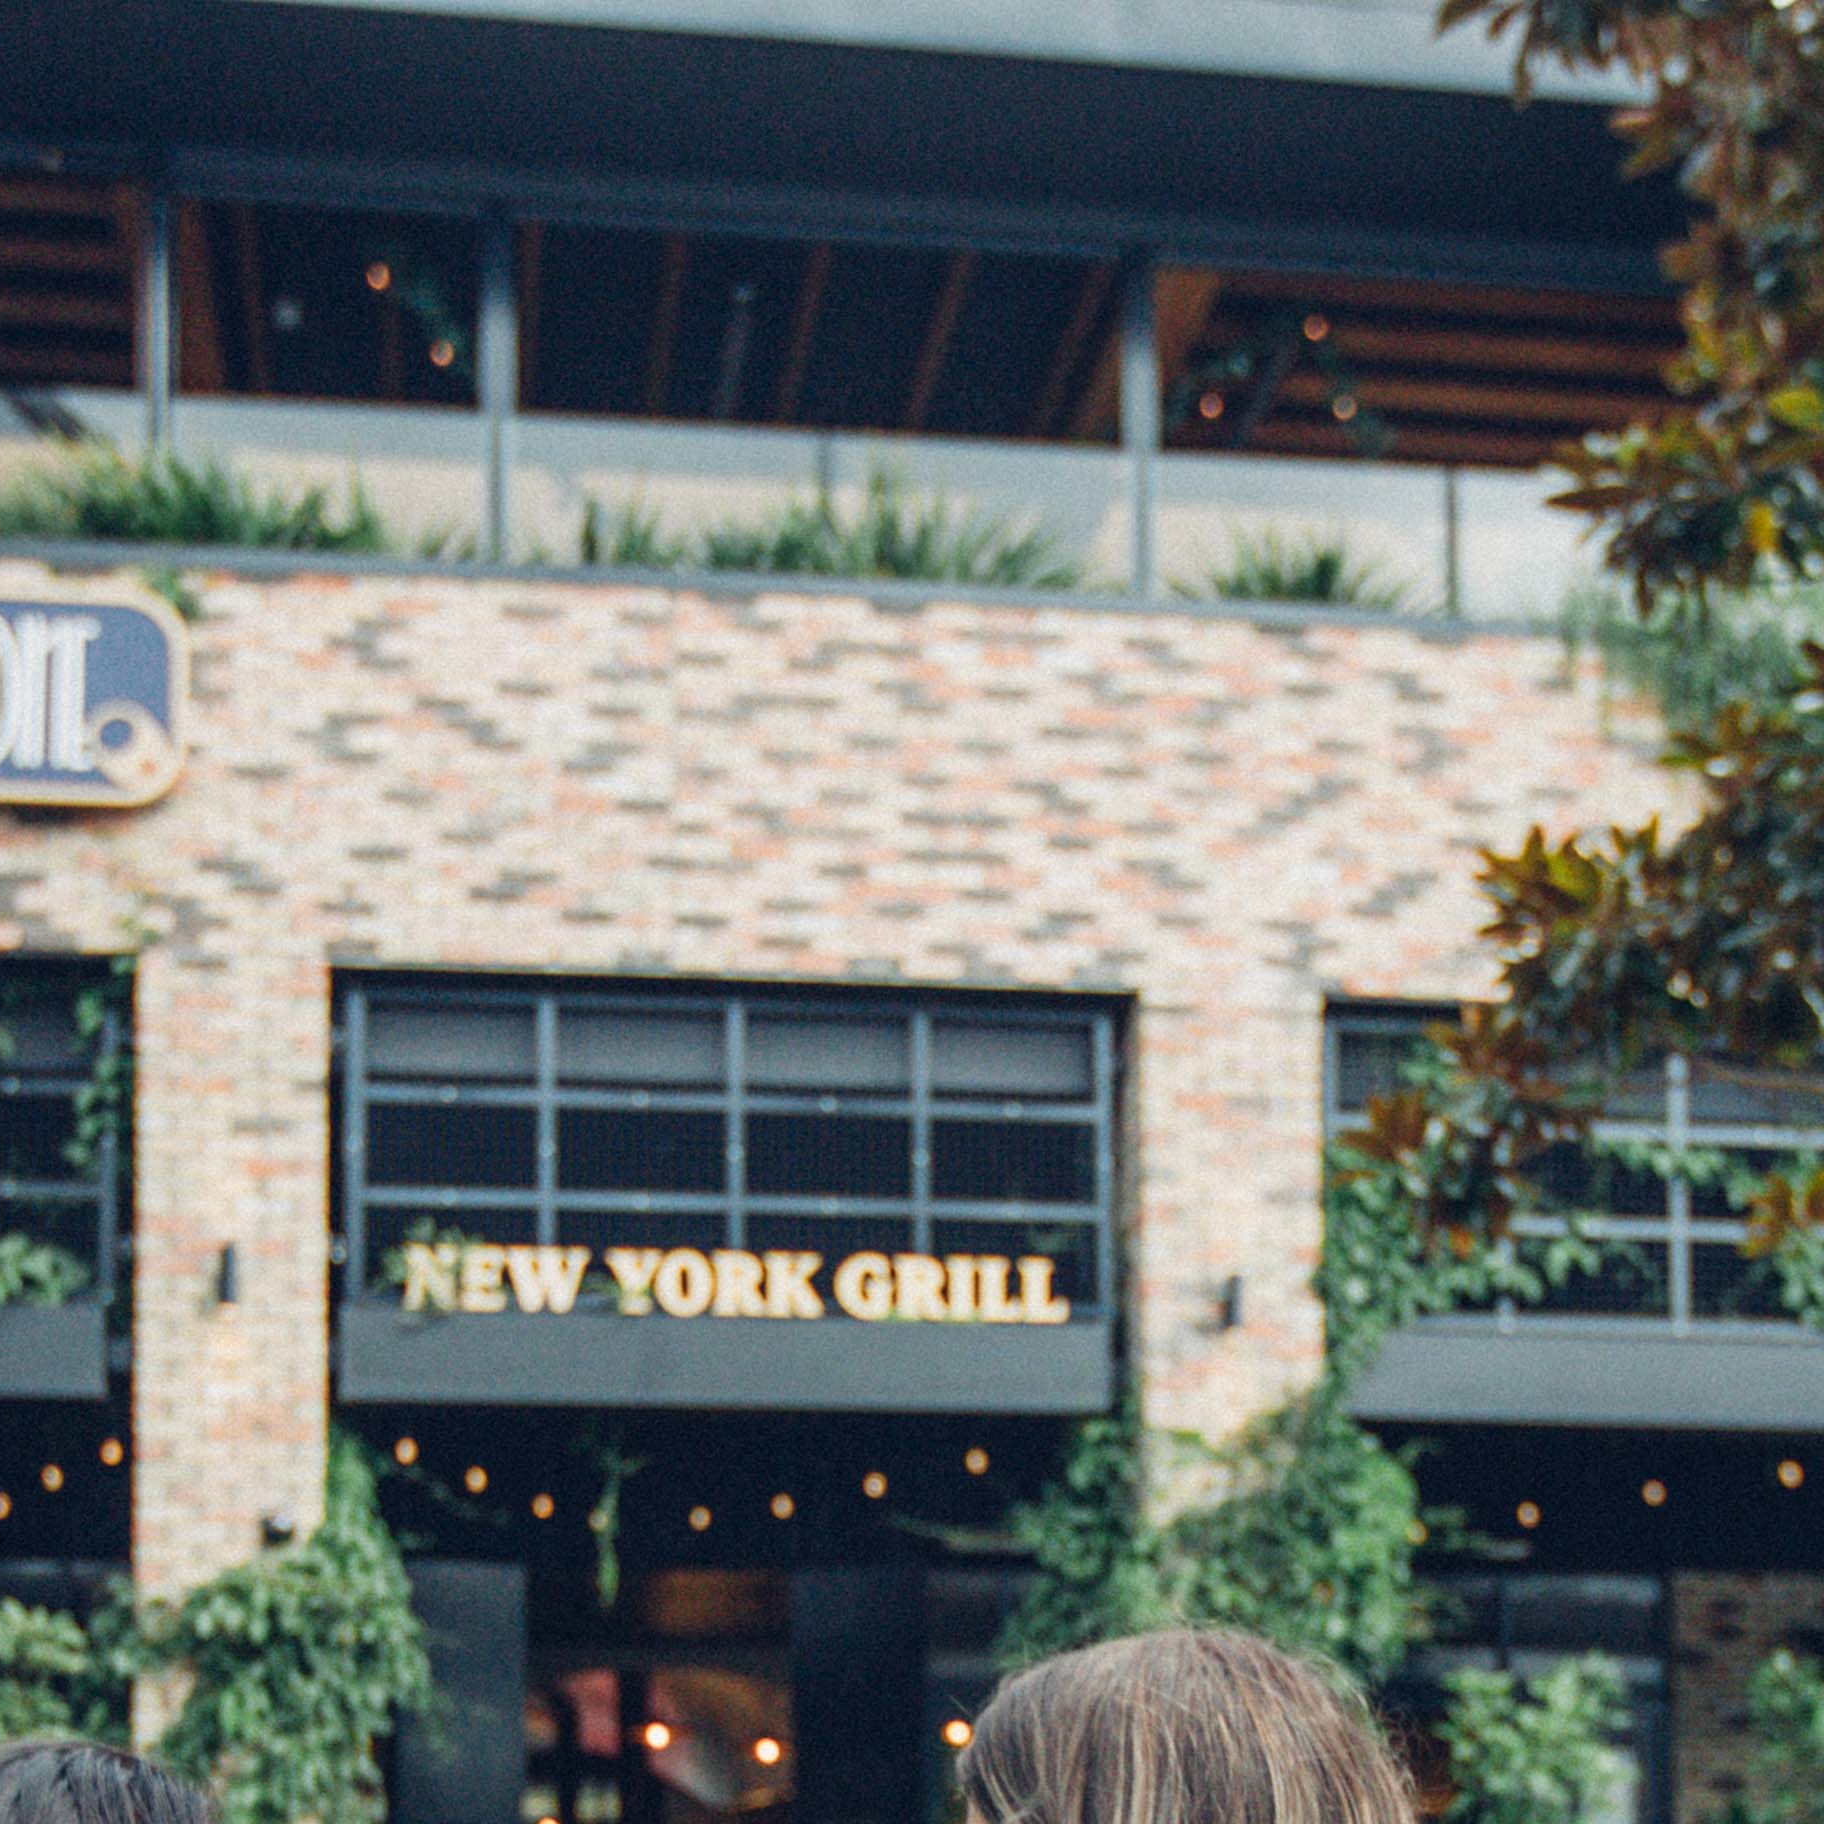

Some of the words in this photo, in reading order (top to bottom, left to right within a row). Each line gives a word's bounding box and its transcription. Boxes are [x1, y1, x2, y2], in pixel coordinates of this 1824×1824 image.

[404, 1242, 590, 1315] NEW
[606, 1247, 825, 1319] YORK
[834, 1251, 1071, 1325] GRILL
